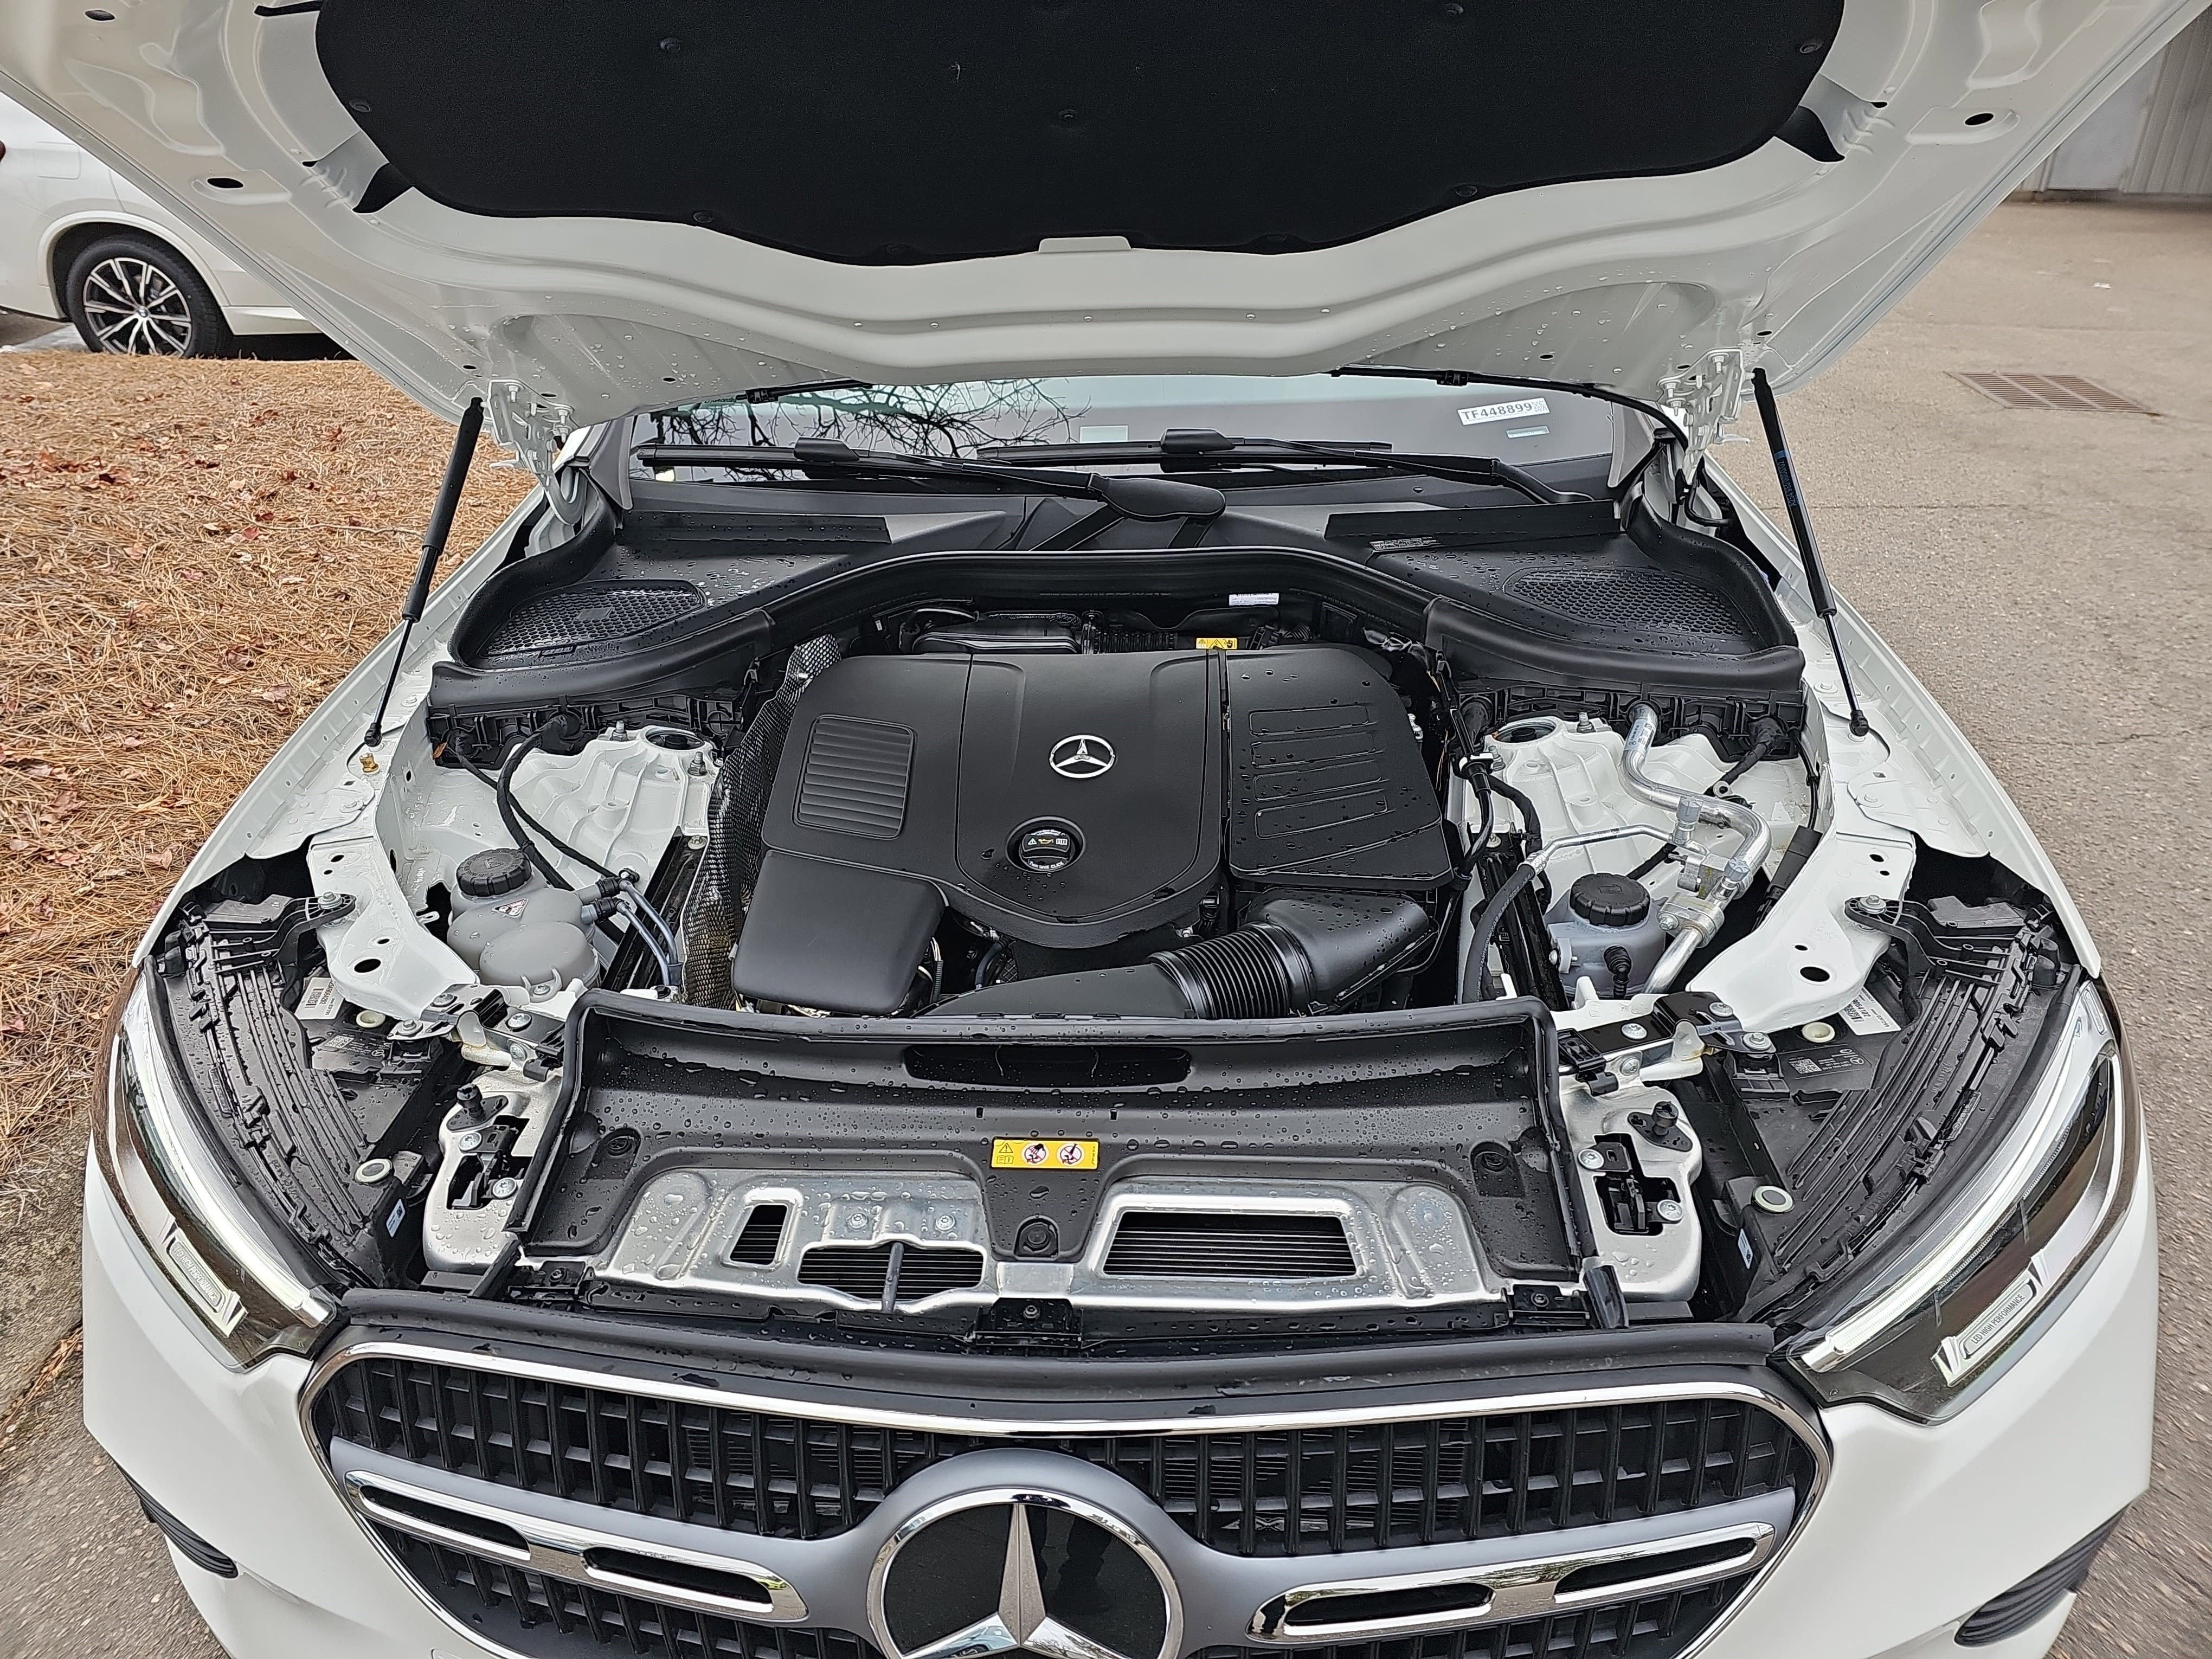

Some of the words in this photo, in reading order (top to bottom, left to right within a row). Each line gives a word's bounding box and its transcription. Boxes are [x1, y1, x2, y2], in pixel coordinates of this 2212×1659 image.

[1461, 402, 1533, 420] TF448899
[1050, 860, 1065, 869] CLICK
[181, 1254, 194, 1270] HIGH
[189, 1263, 221, 1302] PERFORMANCE
[1971, 1332, 1983, 1344] LED
[1980, 1319, 1996, 1338] HIGH
[1992, 1294, 2025, 1329] PERFORMANCE
